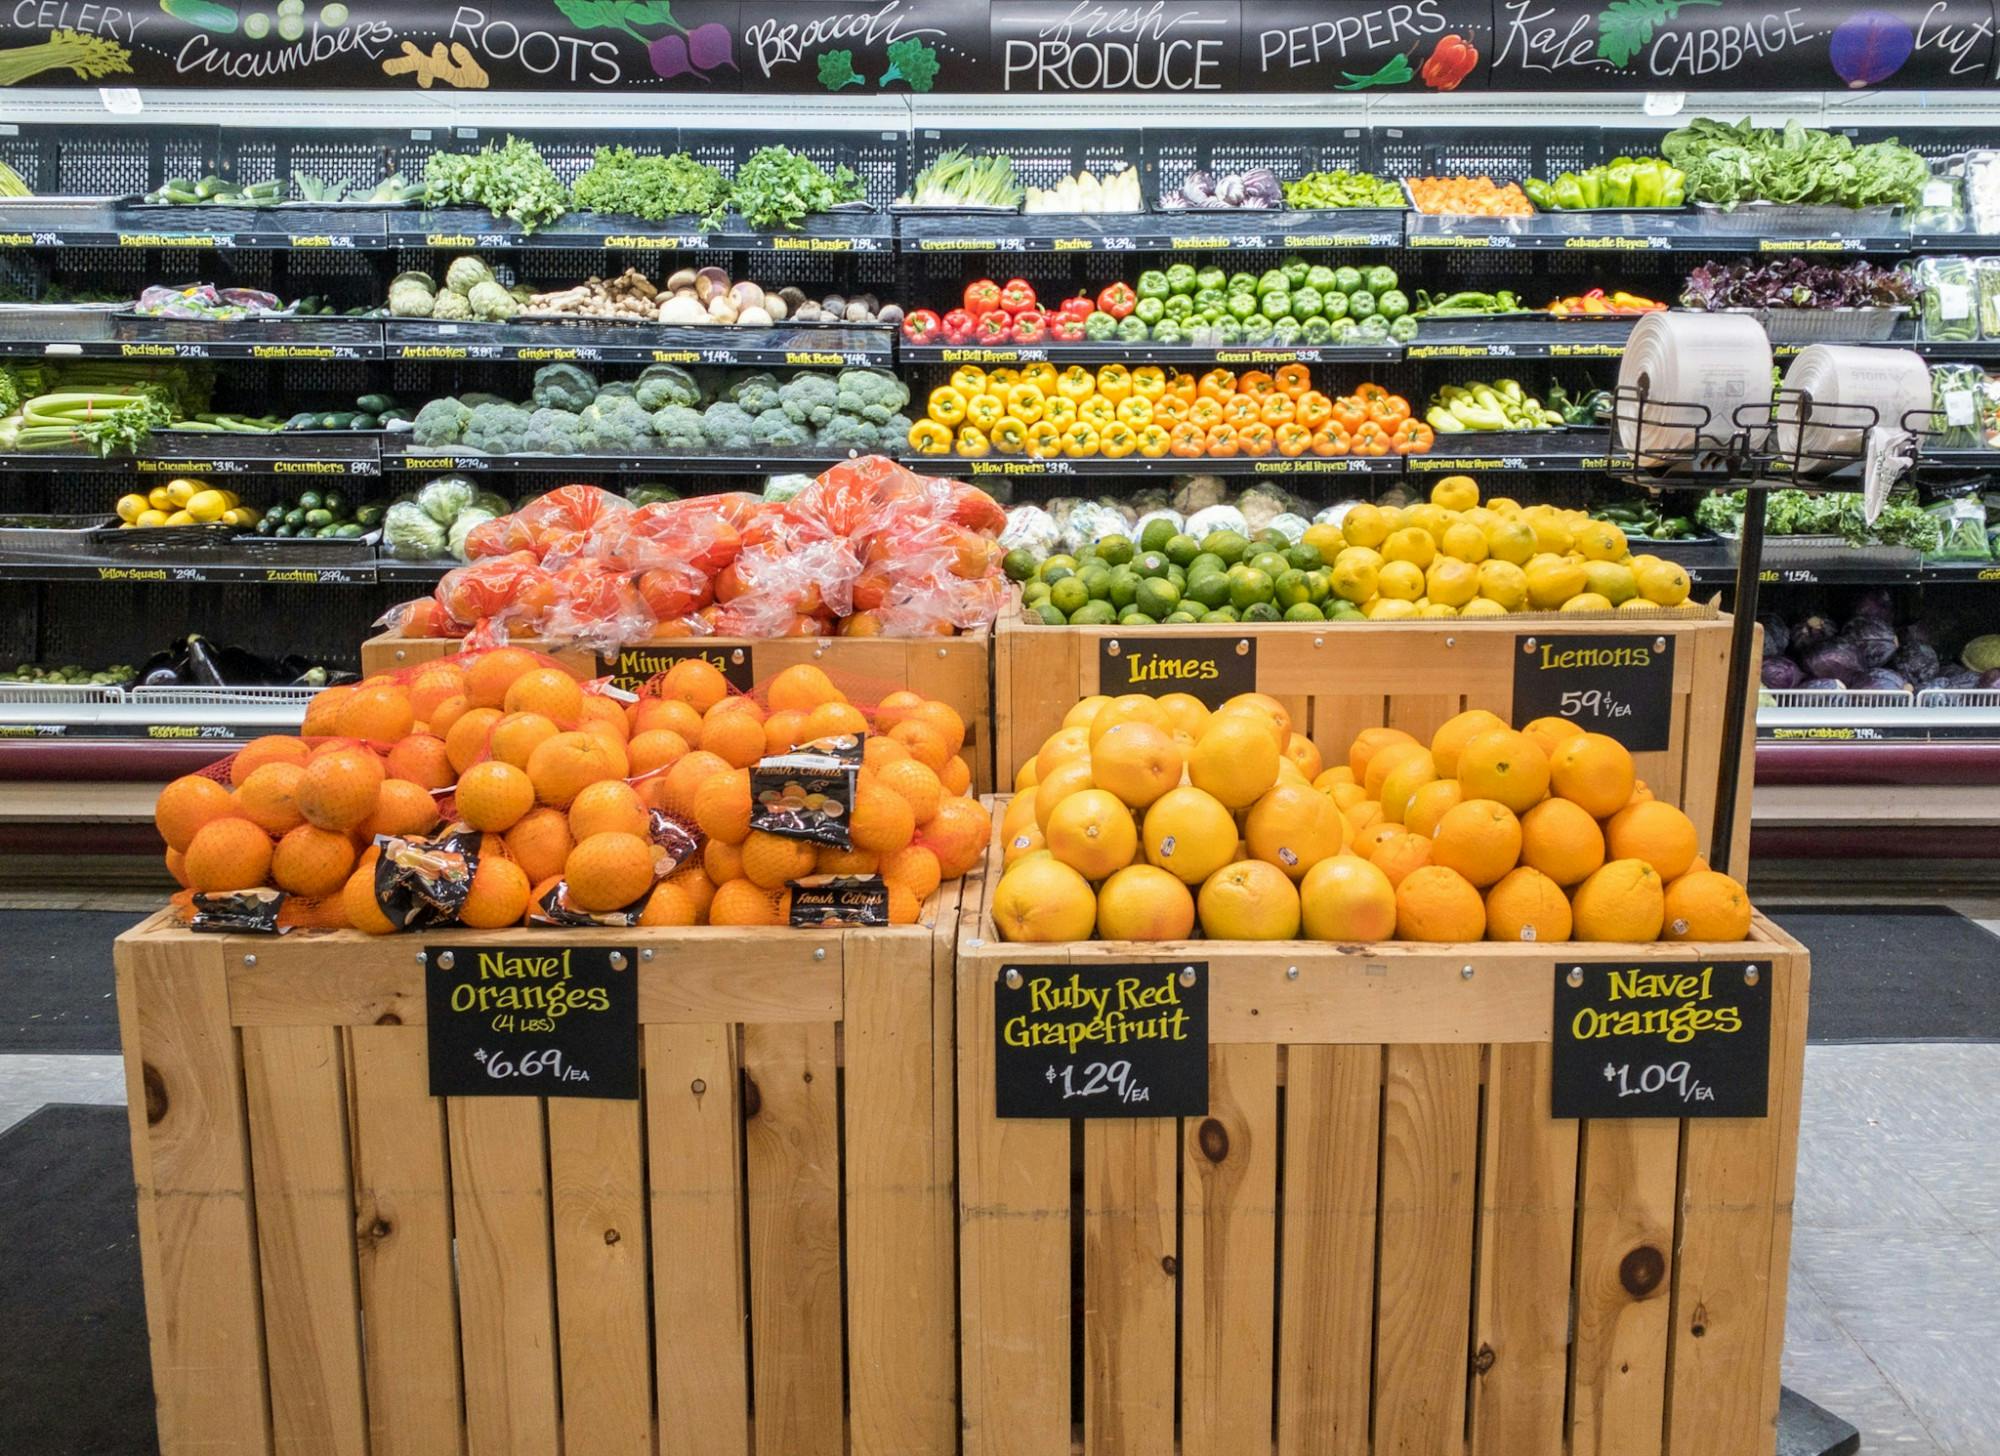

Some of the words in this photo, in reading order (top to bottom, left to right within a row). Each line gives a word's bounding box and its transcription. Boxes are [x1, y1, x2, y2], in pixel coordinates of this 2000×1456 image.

[13, 0, 149, 43] CELERY
[1039, 0, 1199, 55] fresh
[745, 0, 946, 78] Broccoli
[1260, 0, 1447, 72] PEPPERS
[1492, 0, 1615, 73] Kale
[1650, 7, 1814, 76] CABBAGE
[176, 21, 395, 78] Cucumbers
[449, 6, 621, 85] ROOTS
[1004, 41, 1223, 91] PRODUCE
[120, 234, 160, 248] English
[160, 236, 212, 249] Cucumbers
[291, 236, 331, 248] Leeks
[427, 235, 476, 247] Cilantro
[604, 235, 636, 249] Curly
[637, 236, 680, 249] Parsley
[773, 238, 808, 250] Italian
[810, 238, 852, 252] Parsley
[921, 240, 954, 251] Green
[956, 240, 997, 251] Onions
[1054, 239, 1093, 250] Endive
[1172, 237, 1231, 249] Radicchio
[1333, 235, 1370, 247] Peppers
[1409, 235, 1455, 248] Habanero
[1454, 236, 1489, 248] Peppers
[1565, 236, 1615, 248] Cubanelle
[1615, 236, 1648, 250] Peppers
[1759, 239, 1806, 251] Romaine
[1805, 239, 1843, 251] Lettuce
[122, 344, 175, 357] Radishes
[253, 346, 289, 359] English
[289, 346, 336, 357] Cucumbers
[401, 346, 467, 359] Artichokes
[517, 348, 552, 361] Ginger
[552, 348, 577, 361] Root
[652, 350, 700, 363] Turnips
[943, 349, 962, 361] Red
[963, 349, 982, 361] Bell
[982, 349, 1018, 362] Peppers
[1216, 351, 1250, 362] Green
[1252, 350, 1297, 363] Peppers
[1550, 345, 1572, 356] Mini
[1573, 344, 1599, 355] Sweet
[786, 352, 813, 365] Bulk
[813, 353, 844, 365] Beets
[137, 461, 157, 472] Mini
[158, 461, 213, 472] Cucumbers
[273, 462, 345, 474] Cucumbers
[406, 458, 454, 470] Broccoli
[971, 462, 1003, 475] Yellow
[1005, 462, 1046, 476] Peppers
[1255, 462, 1293, 474] Orange
[1294, 461, 1313, 472] Bell
[1314, 460, 1346, 473] Peppers
[1409, 460, 1455, 472] Hungarian
[1474, 460, 1504, 471] Peppers
[99, 568, 130, 580] Yellow
[130, 568, 167, 582] Squash
[266, 570, 318, 582] Zucchini
[1759, 570, 1780, 582] ale
[1540, 643, 1651, 670] Lemons
[1126, 653, 1220, 684] Limes
[147, 726, 199, 738] Eggplant
[1808, 728, 1856, 740] Cabbage
[477, 948, 573, 980] Navel
[1607, 966, 1713, 1002] Navel
[451, 981, 611, 1017] Oranges
[1028, 974, 1112, 1021] Ruby
[1116, 973, 1181, 1011] Red
[1572, 1001, 1743, 1044] Oranges
[1004, 1007, 1191, 1054] Grapefruit
[473, 1047, 591, 1082] $6.69/EA
[1045, 1060, 1150, 1104] $1.29/EA
[1602, 1061, 1715, 1103] $1.09/EA
